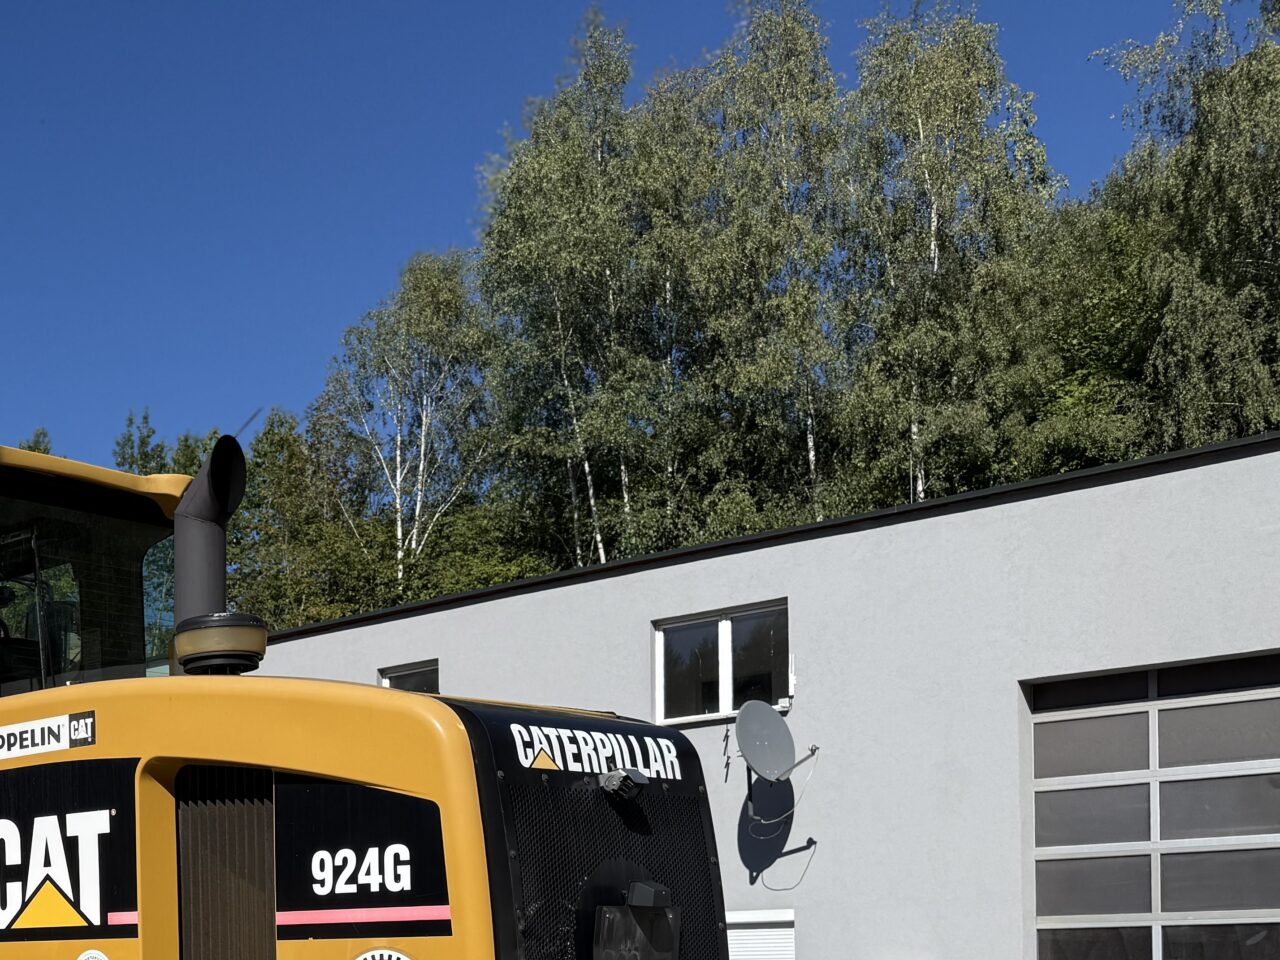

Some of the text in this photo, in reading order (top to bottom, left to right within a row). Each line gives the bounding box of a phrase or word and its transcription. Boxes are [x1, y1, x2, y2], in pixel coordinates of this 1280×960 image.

[70, 718, 94, 741] CAT
[509, 722, 683, 781] CATERPILLAR
[310, 843, 412, 896] 924G
